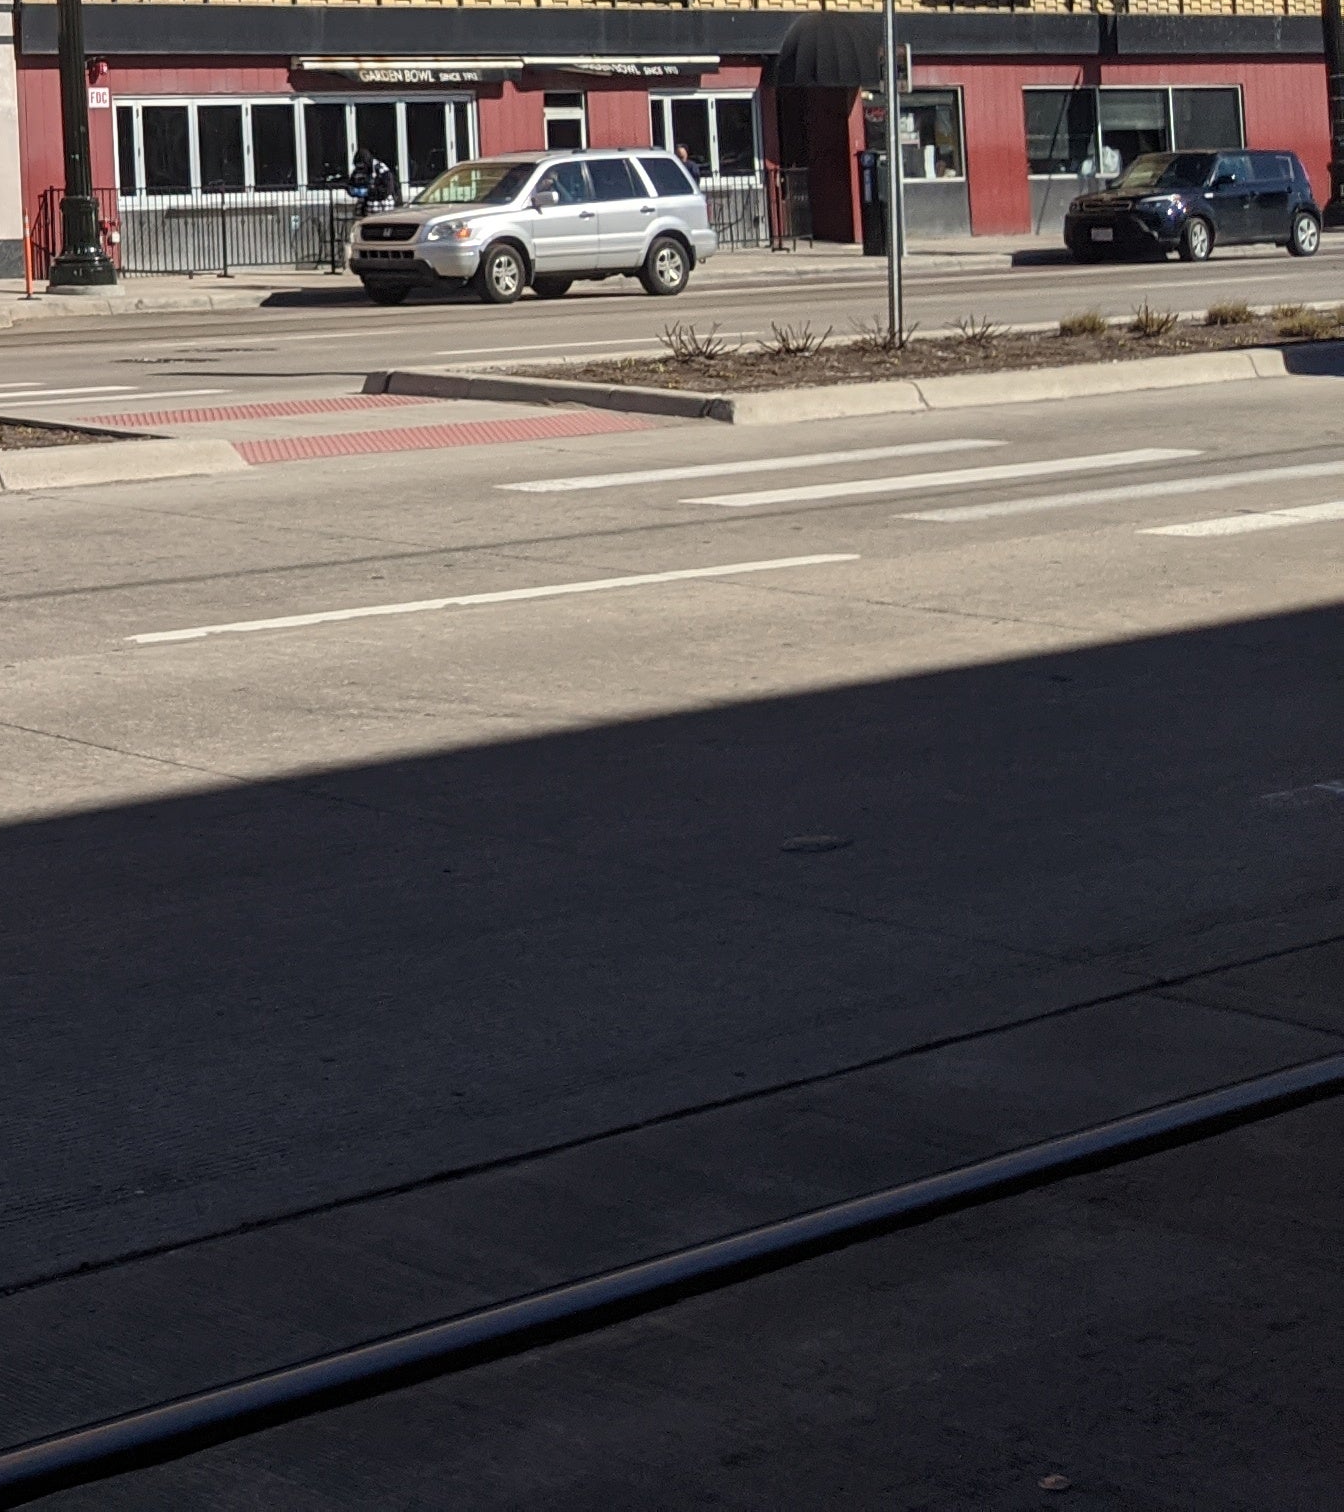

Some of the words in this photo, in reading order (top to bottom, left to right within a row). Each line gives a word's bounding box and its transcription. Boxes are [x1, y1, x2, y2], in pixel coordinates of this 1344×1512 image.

[359, 69, 403, 83] GARDEN
[403, 69, 435, 83] BOWL
[90, 91, 107, 104] FDC
